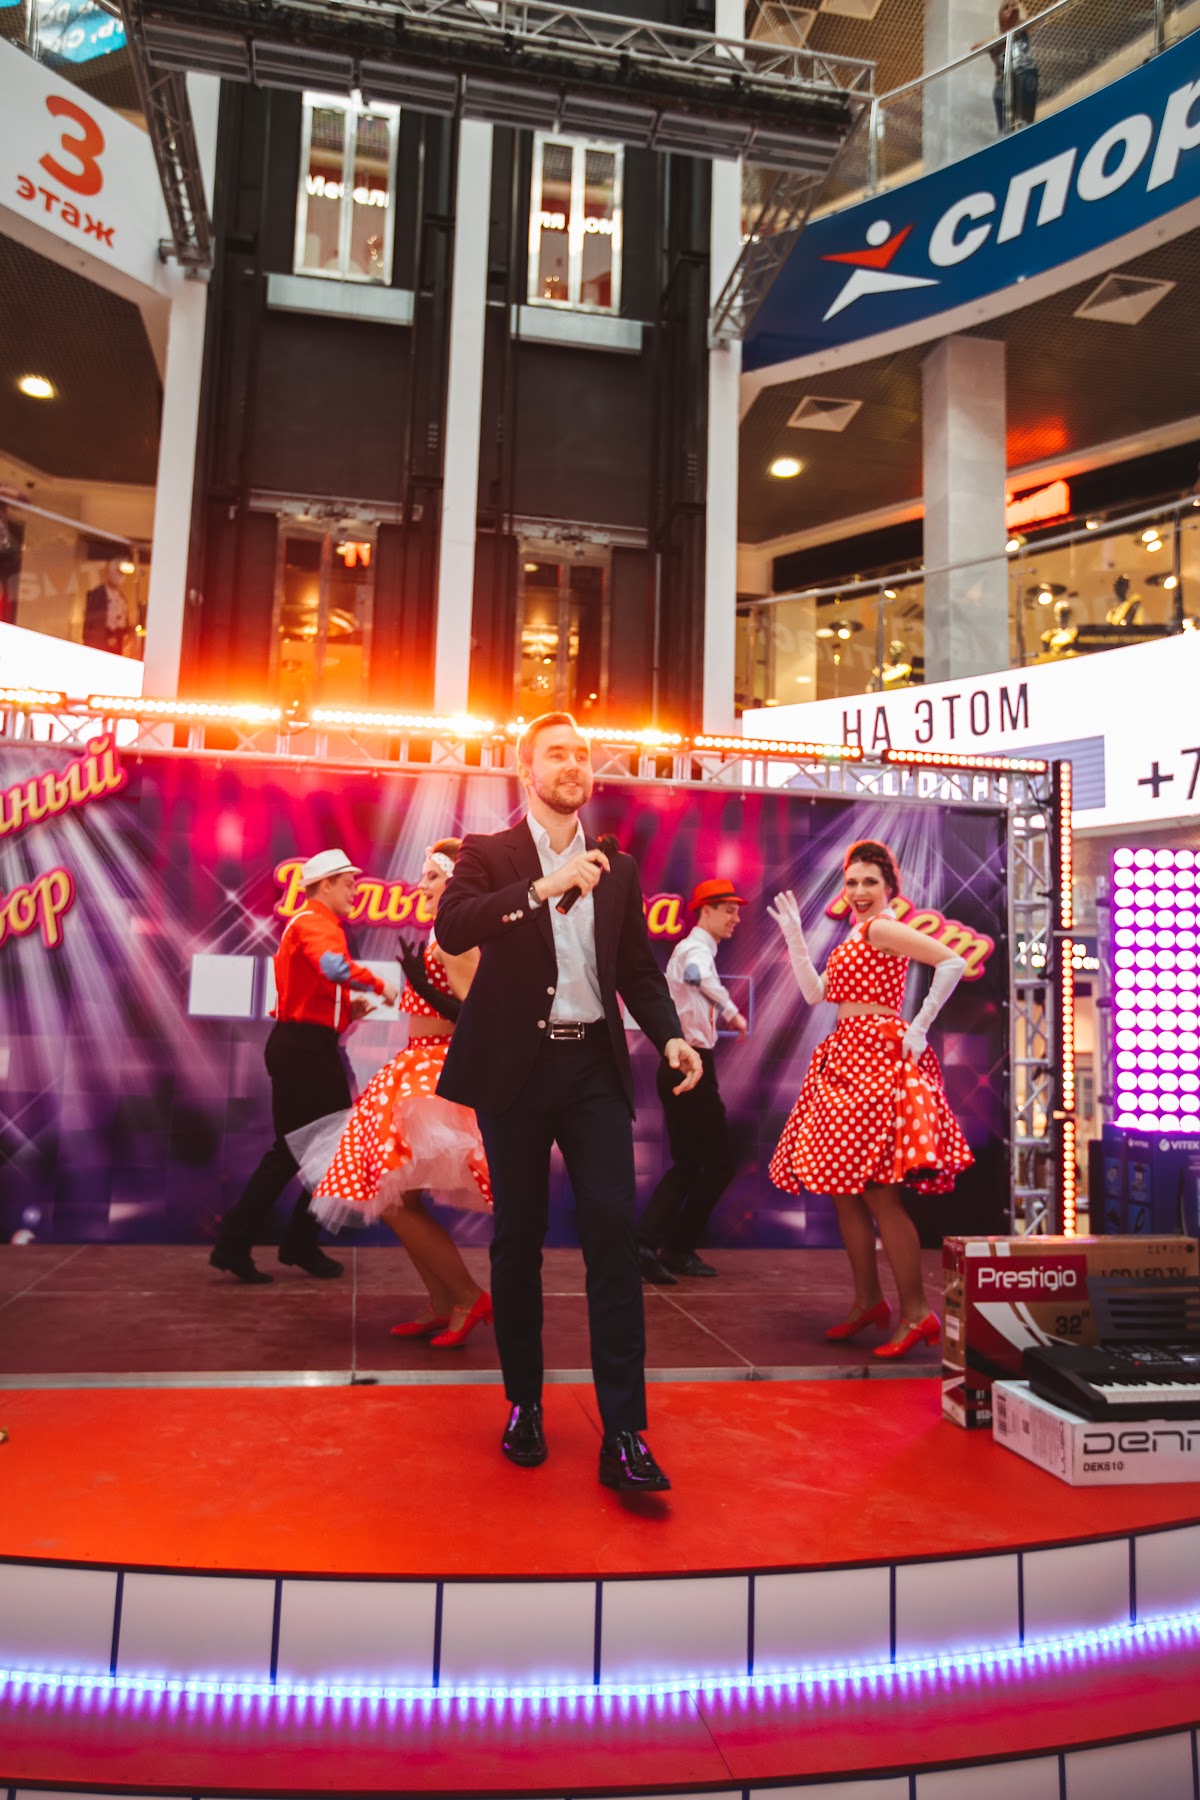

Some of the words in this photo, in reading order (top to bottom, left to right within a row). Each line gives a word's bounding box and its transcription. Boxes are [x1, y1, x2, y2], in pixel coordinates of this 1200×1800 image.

[38, 95, 106, 197] 3
[16, 174, 116, 249] этаж
[305, 174, 390, 209] Меел
[842, 705, 893, 750] НА
[913, 682, 1030, 744] ЭТОМ
[0, 735, 123, 835] ный
[0, 870, 71, 945] ор
[1170, 1140, 1200, 1150] VITEK
[978, 1265, 1077, 1291] Prestigio
[1083, 1461, 1124, 1473] DEK610
